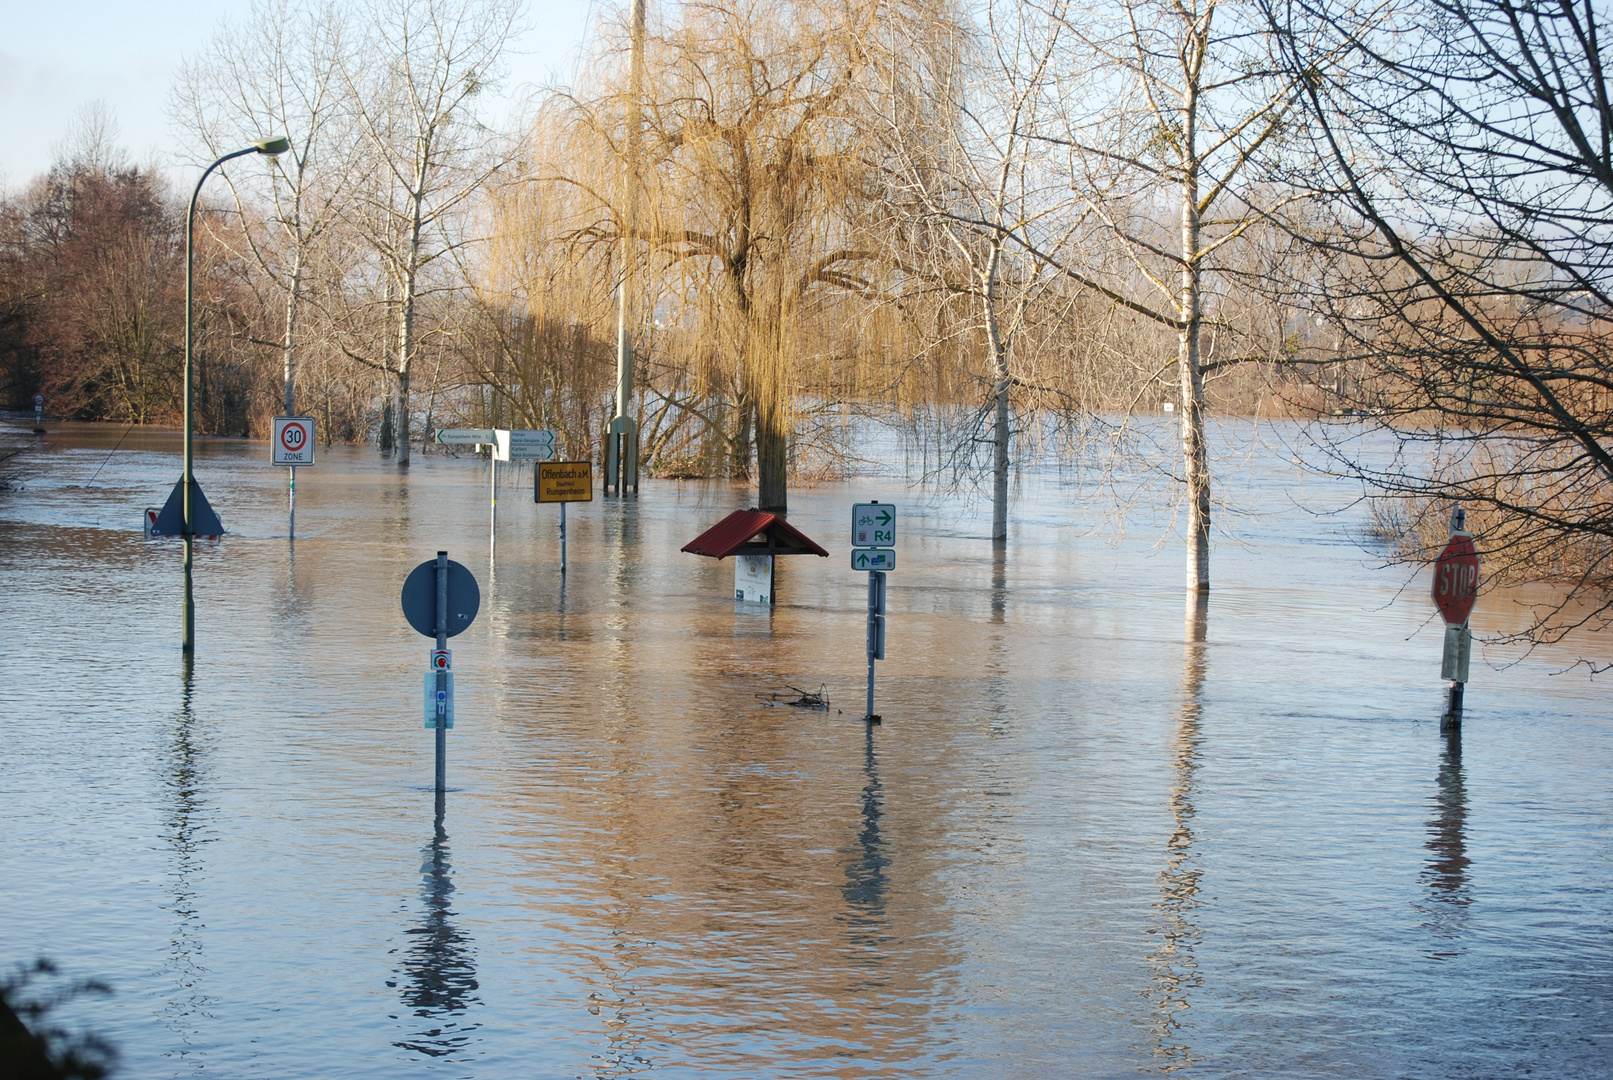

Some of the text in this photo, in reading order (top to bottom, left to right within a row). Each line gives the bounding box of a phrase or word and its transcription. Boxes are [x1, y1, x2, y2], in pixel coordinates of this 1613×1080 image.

[286, 430, 302, 444] 30
[283, 453, 304, 461] ZONE
[541, 468, 577, 480] Offenbach
[546, 488, 586, 496] Rumpenheim
[874, 530, 892, 542] R4
[1440, 563, 1476, 597] STOP
